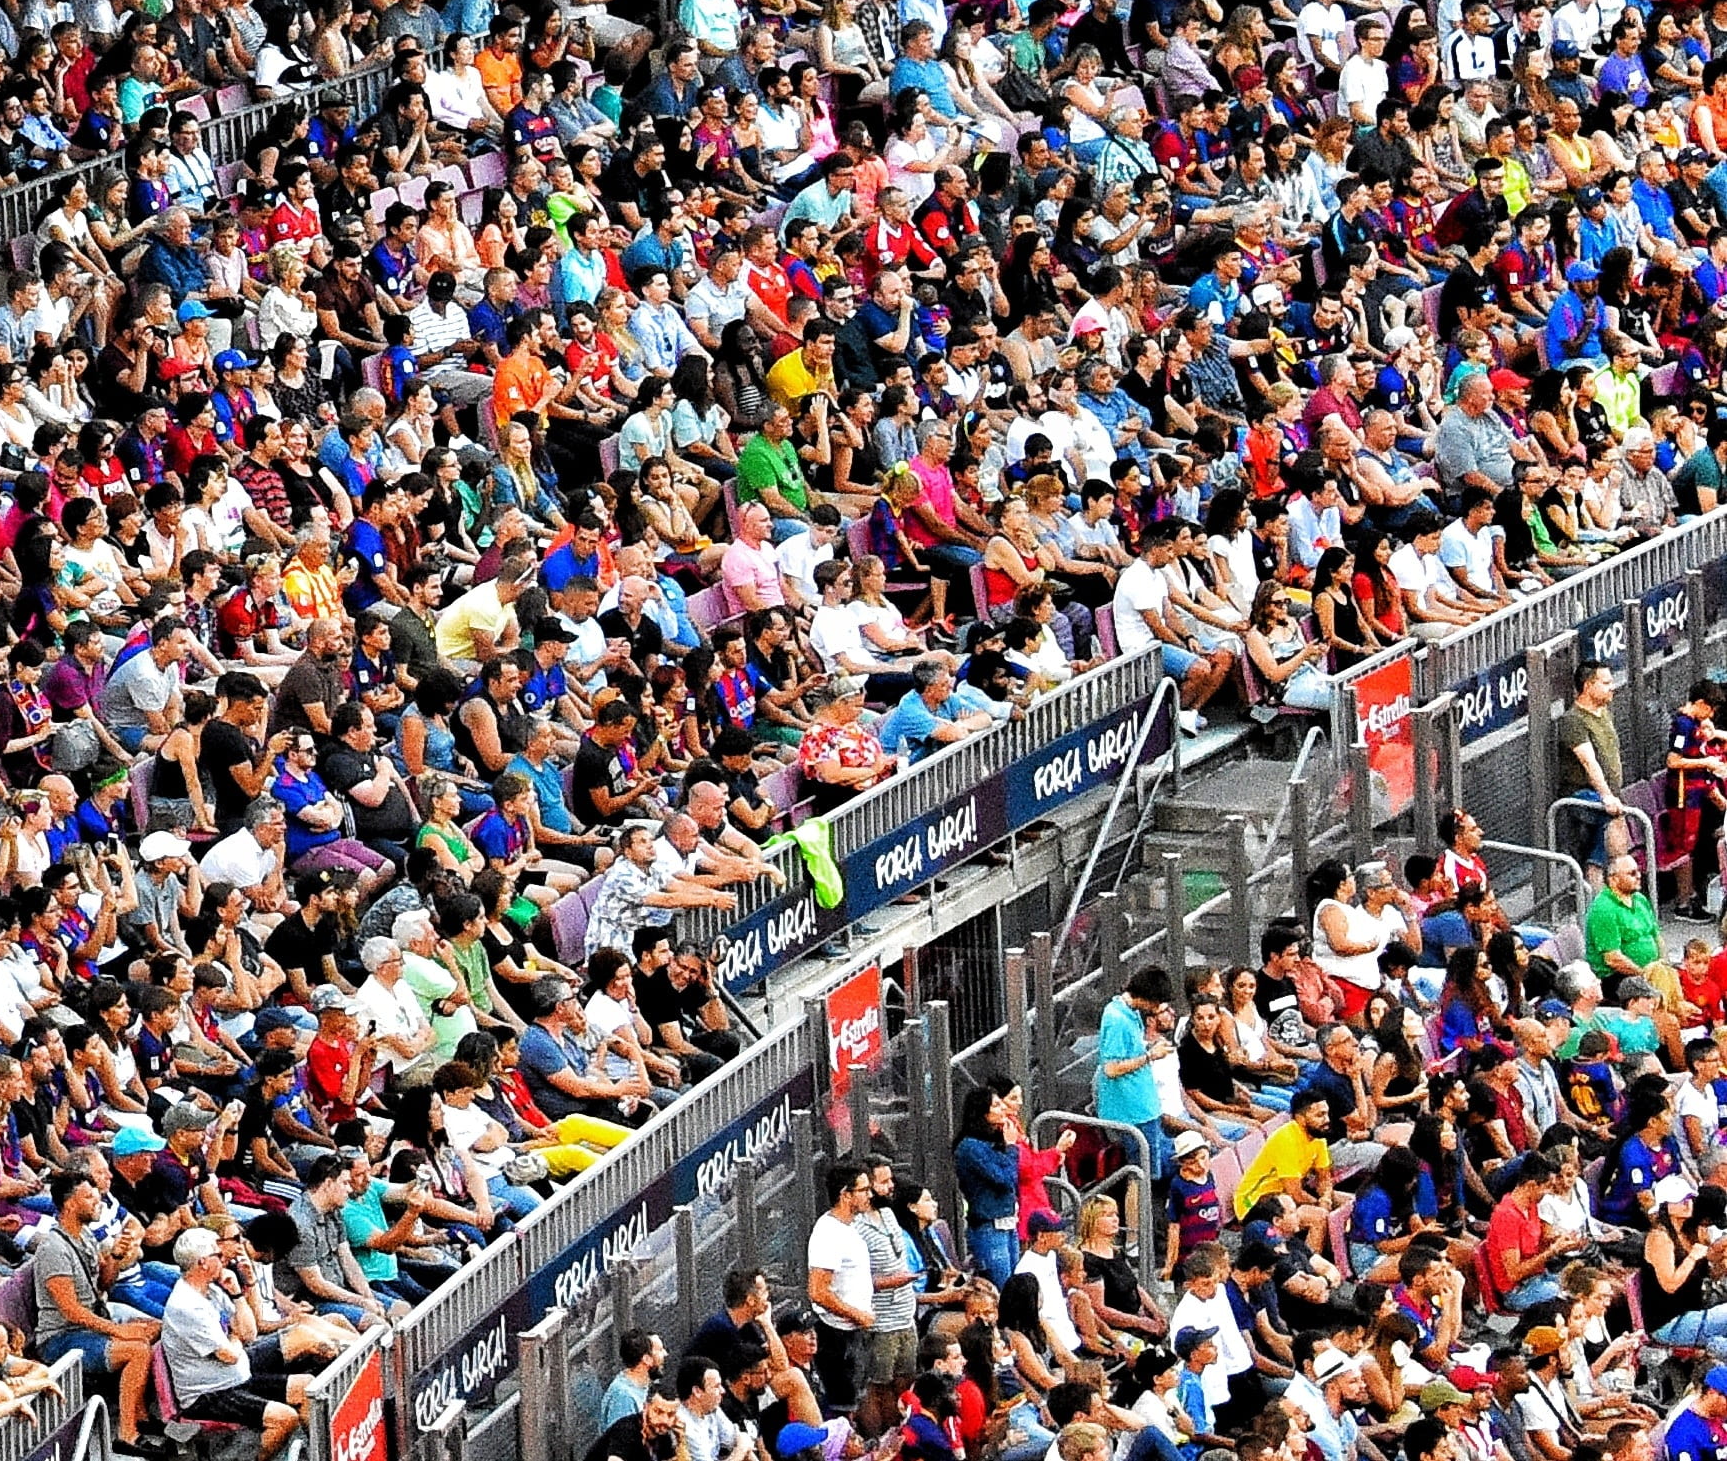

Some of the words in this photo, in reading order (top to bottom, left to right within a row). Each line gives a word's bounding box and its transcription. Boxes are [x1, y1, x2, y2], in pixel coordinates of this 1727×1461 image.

[1594, 621, 1626, 662] FOR
[1647, 591, 1688, 638] BARÇ
[1457, 682, 1493, 730] ORÇA
[1499, 667, 1528, 710] BAR
[1034, 747, 1083, 801] FORÇA
[1088, 711, 1139, 773] BARÇA!
[875, 833, 923, 890] FORÇA
[928, 795, 978, 861] BARÇA!
[718, 927, 763, 988] FORÇA
[767, 888, 818, 955] BARÇA!
[462, 1315, 508, 1393] BARÇA!
